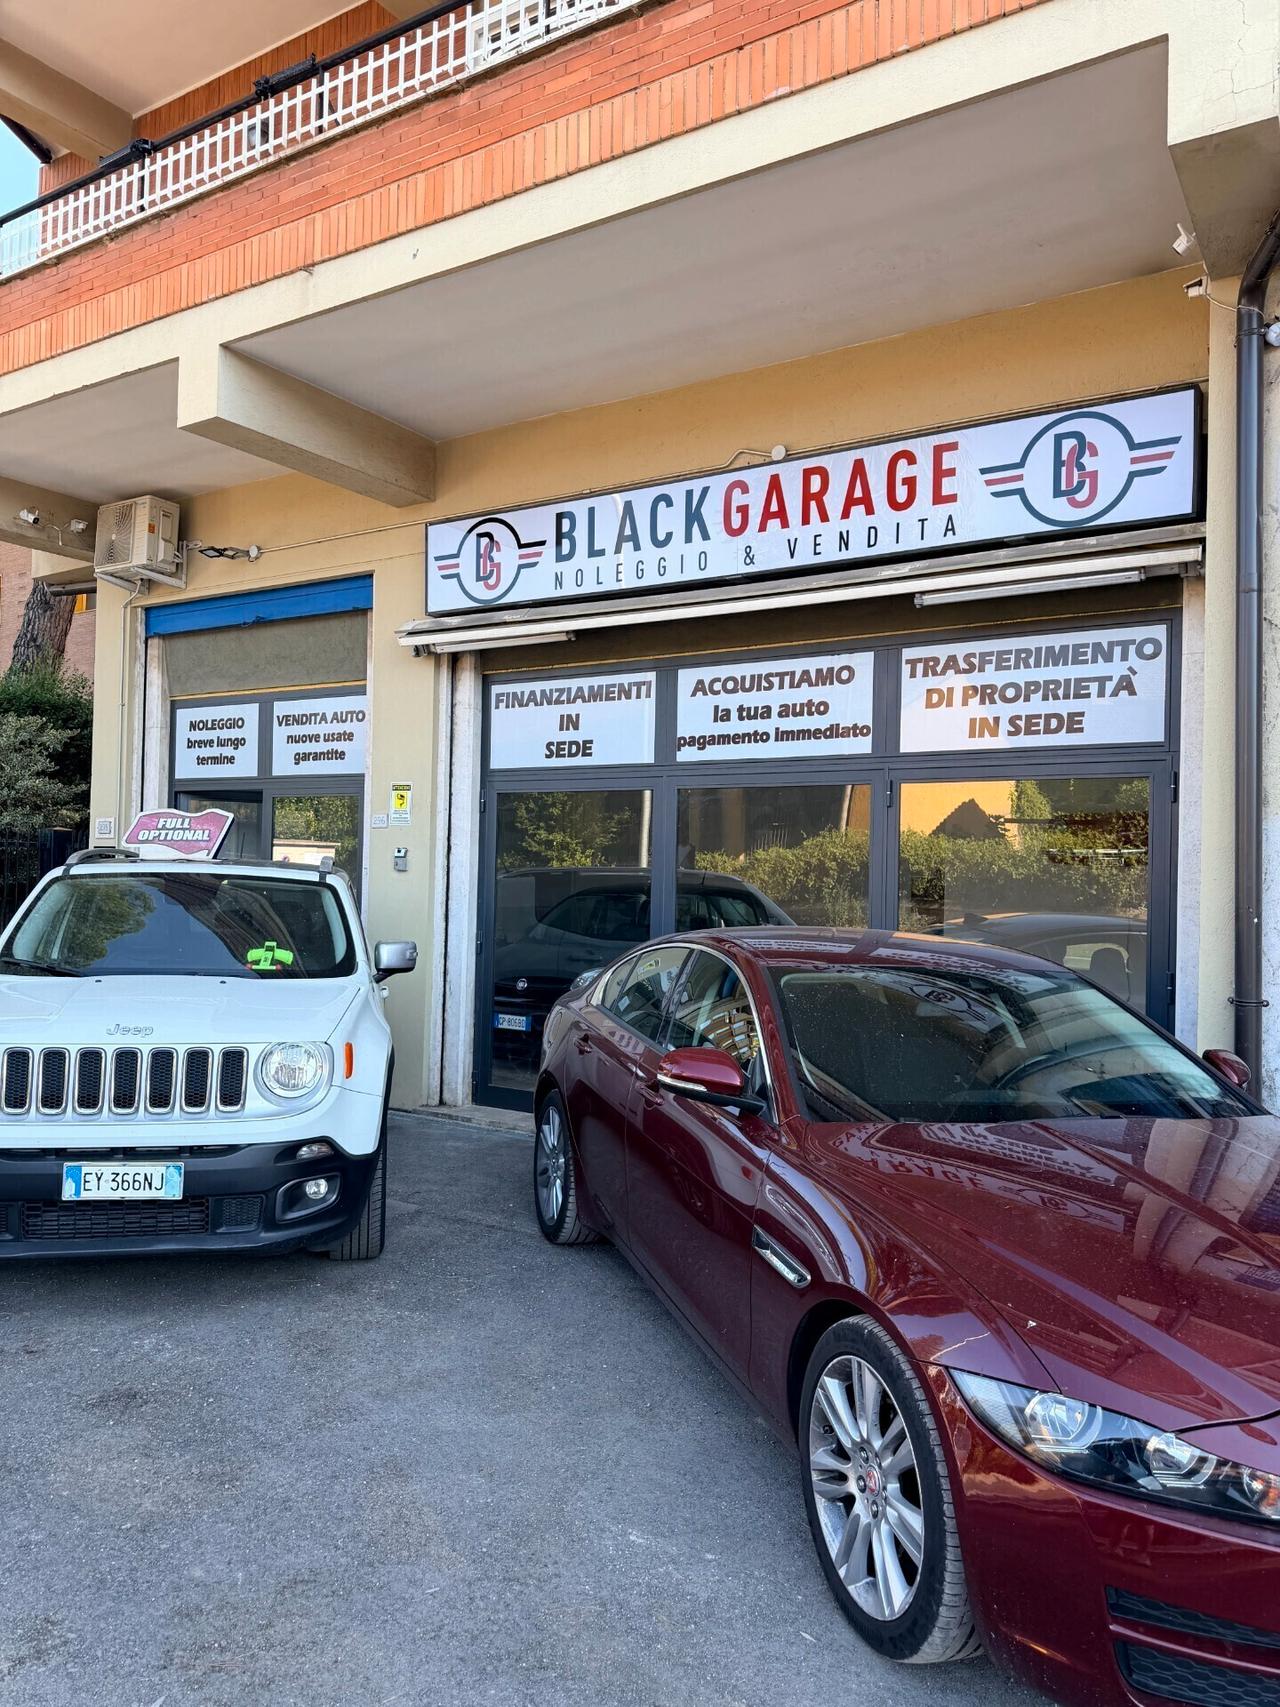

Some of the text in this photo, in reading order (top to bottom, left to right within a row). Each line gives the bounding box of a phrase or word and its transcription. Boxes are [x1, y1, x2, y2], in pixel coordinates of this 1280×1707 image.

[554, 514, 957, 590] NOLEGGIO & VENDITA
[905, 637, 1163, 678] TRASFERIMENTO
[690, 664, 855, 697] ACQUISTIAMO
[924, 666, 1138, 709] DI PROPRIETÀ
[494, 680, 652, 710] FINANZIAMENTI
[276, 710, 366, 728] VENDITA AUTO
[713, 698, 830, 723] la tua auto
[189, 717, 245, 732] NOLEGGIO
[558, 713, 580, 732] IN
[968, 711, 1085, 739] IN SEDE
[187, 735, 246, 750] breve lungo
[286, 730, 354, 745] nuove usate
[677, 723, 872, 751] pagamento immediato
[294, 748, 346, 765] garantite
[544, 739, 593, 759] SEDE
[196, 754, 235, 766] termine
[157, 817, 191, 829] FULL
[137, 829, 211, 841] OPTIONAL
[106, 1023, 154, 1038] Jeep
[83, 1171, 164, 1192] EY 366NJ
